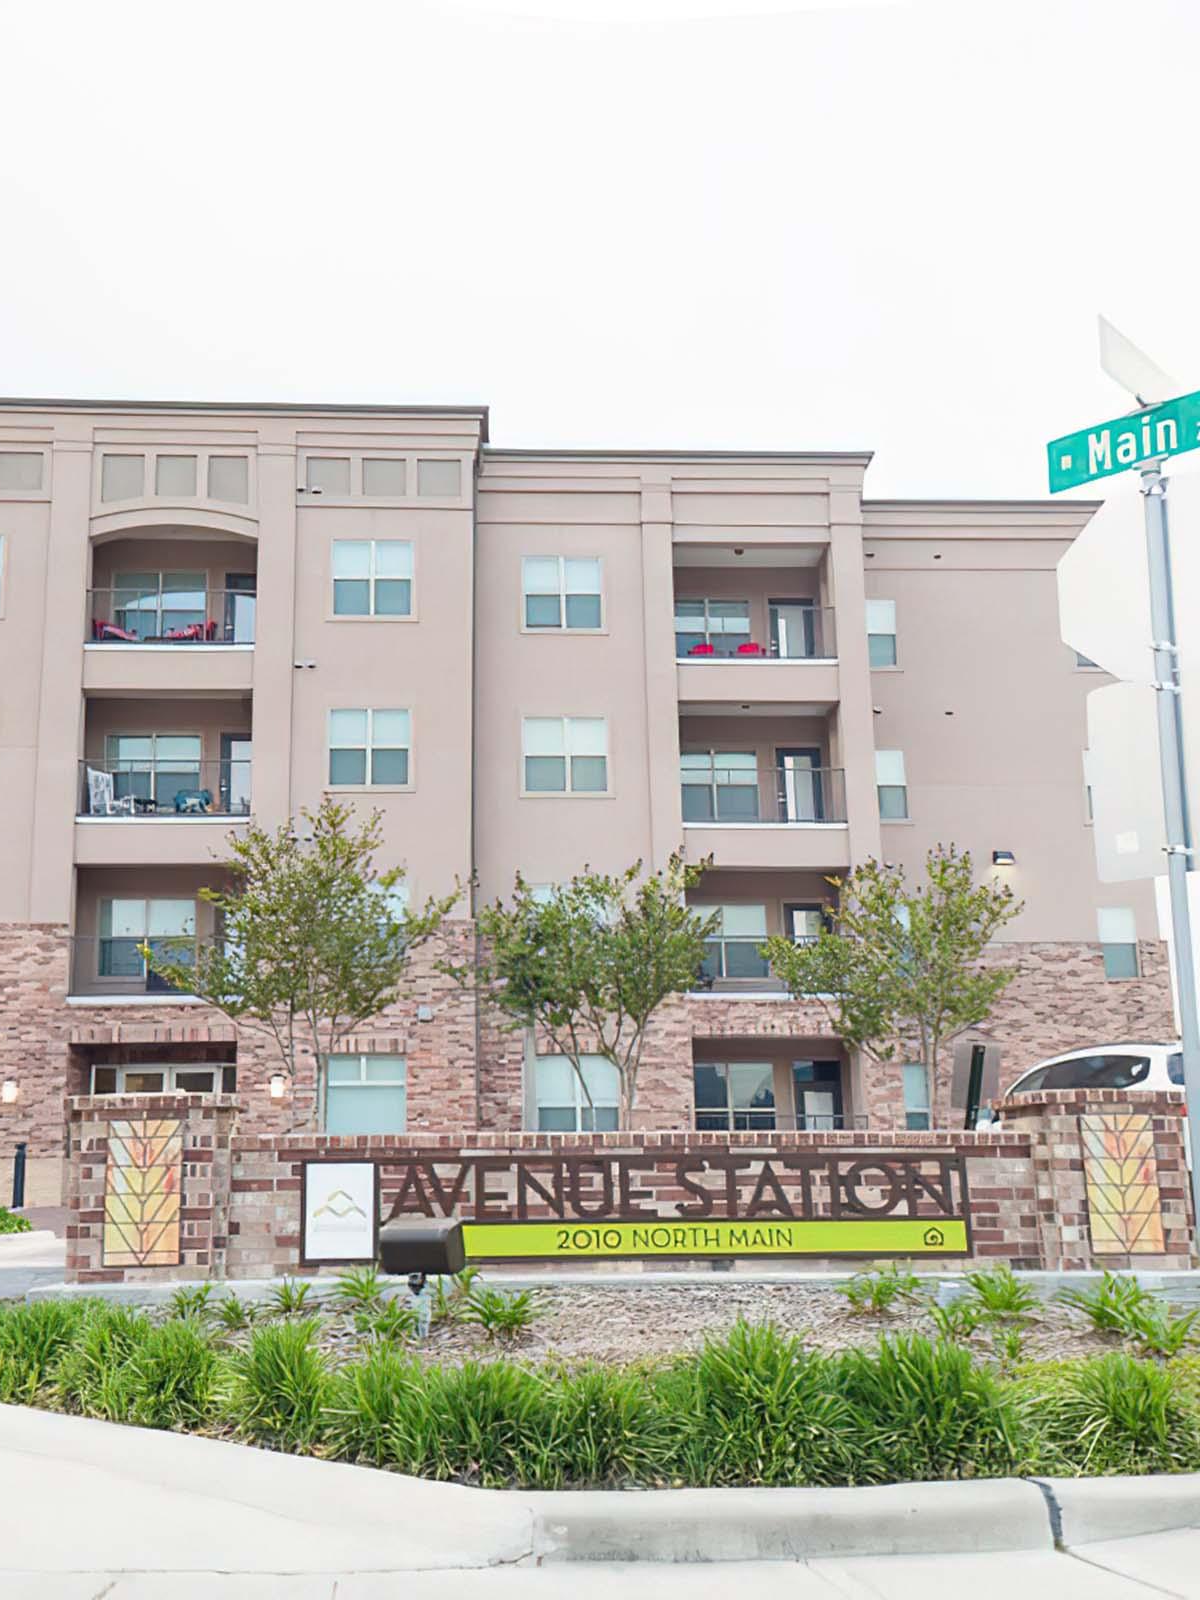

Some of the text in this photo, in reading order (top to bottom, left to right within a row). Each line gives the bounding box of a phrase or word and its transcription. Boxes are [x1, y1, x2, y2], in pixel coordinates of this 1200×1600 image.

[1088, 415, 1178, 475] Main
[382, 1158, 954, 1219] AVENUE STATION
[556, 1227, 793, 1250] 2010 NORTH MAIN
